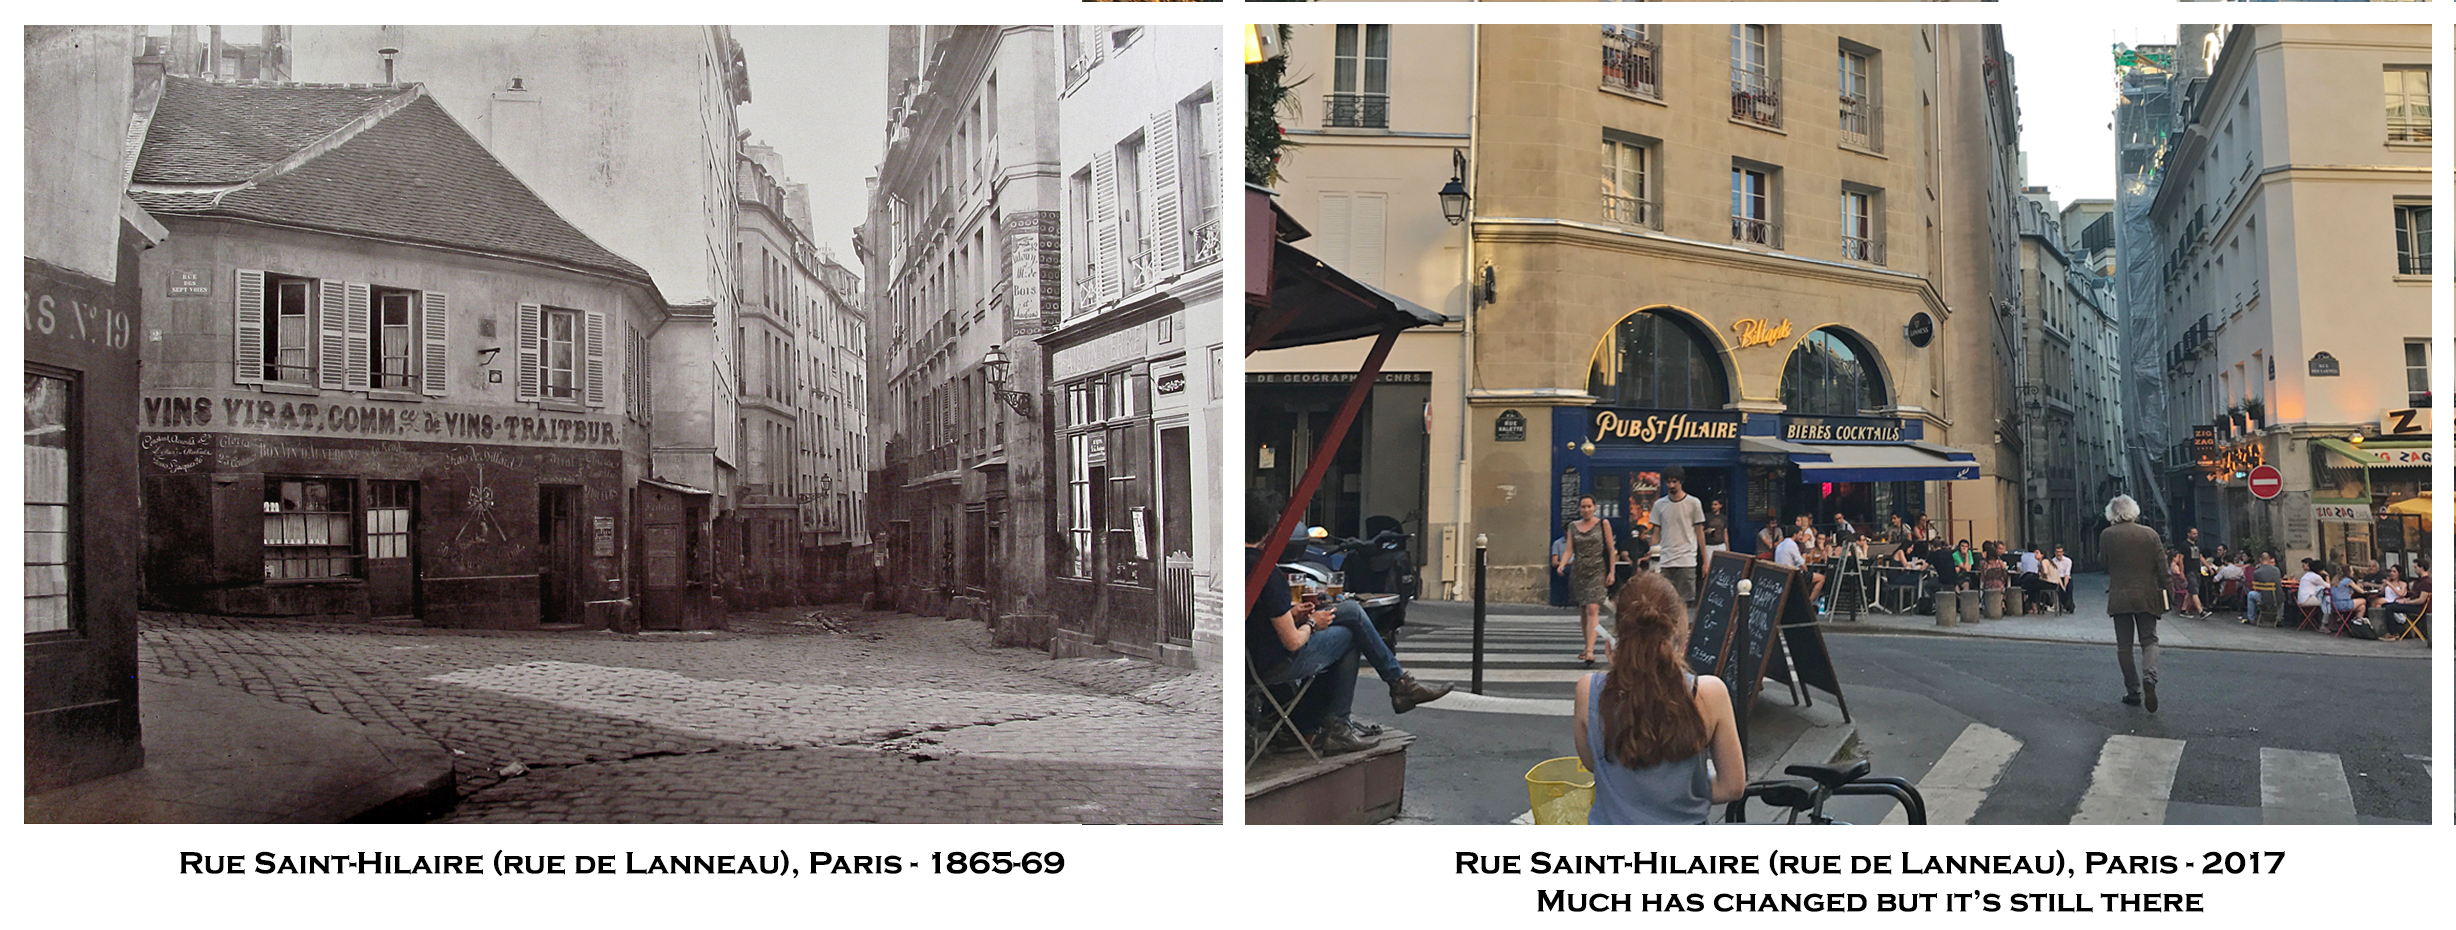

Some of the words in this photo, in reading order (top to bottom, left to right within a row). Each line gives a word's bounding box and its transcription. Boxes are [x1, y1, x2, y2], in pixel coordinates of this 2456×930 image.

[1014, 285, 1037, 296] BOIS
[105, 308, 130, 350] 19
[1731, 318, 1793, 348] Billards
[1257, 374, 1274, 383] DE
[1385, 373, 1421, 382] CNRS
[144, 396, 213, 427] VINS
[1787, 424, 1832, 440] BIERES
[1835, 424, 1900, 442] COCKTAILS
[2399, 451, 2432, 463] ZAG
[2316, 507, 2334, 517] ZIG
[2334, 506, 2355, 518] ZAG
[1753, 588, 1778, 611] HAPPY
